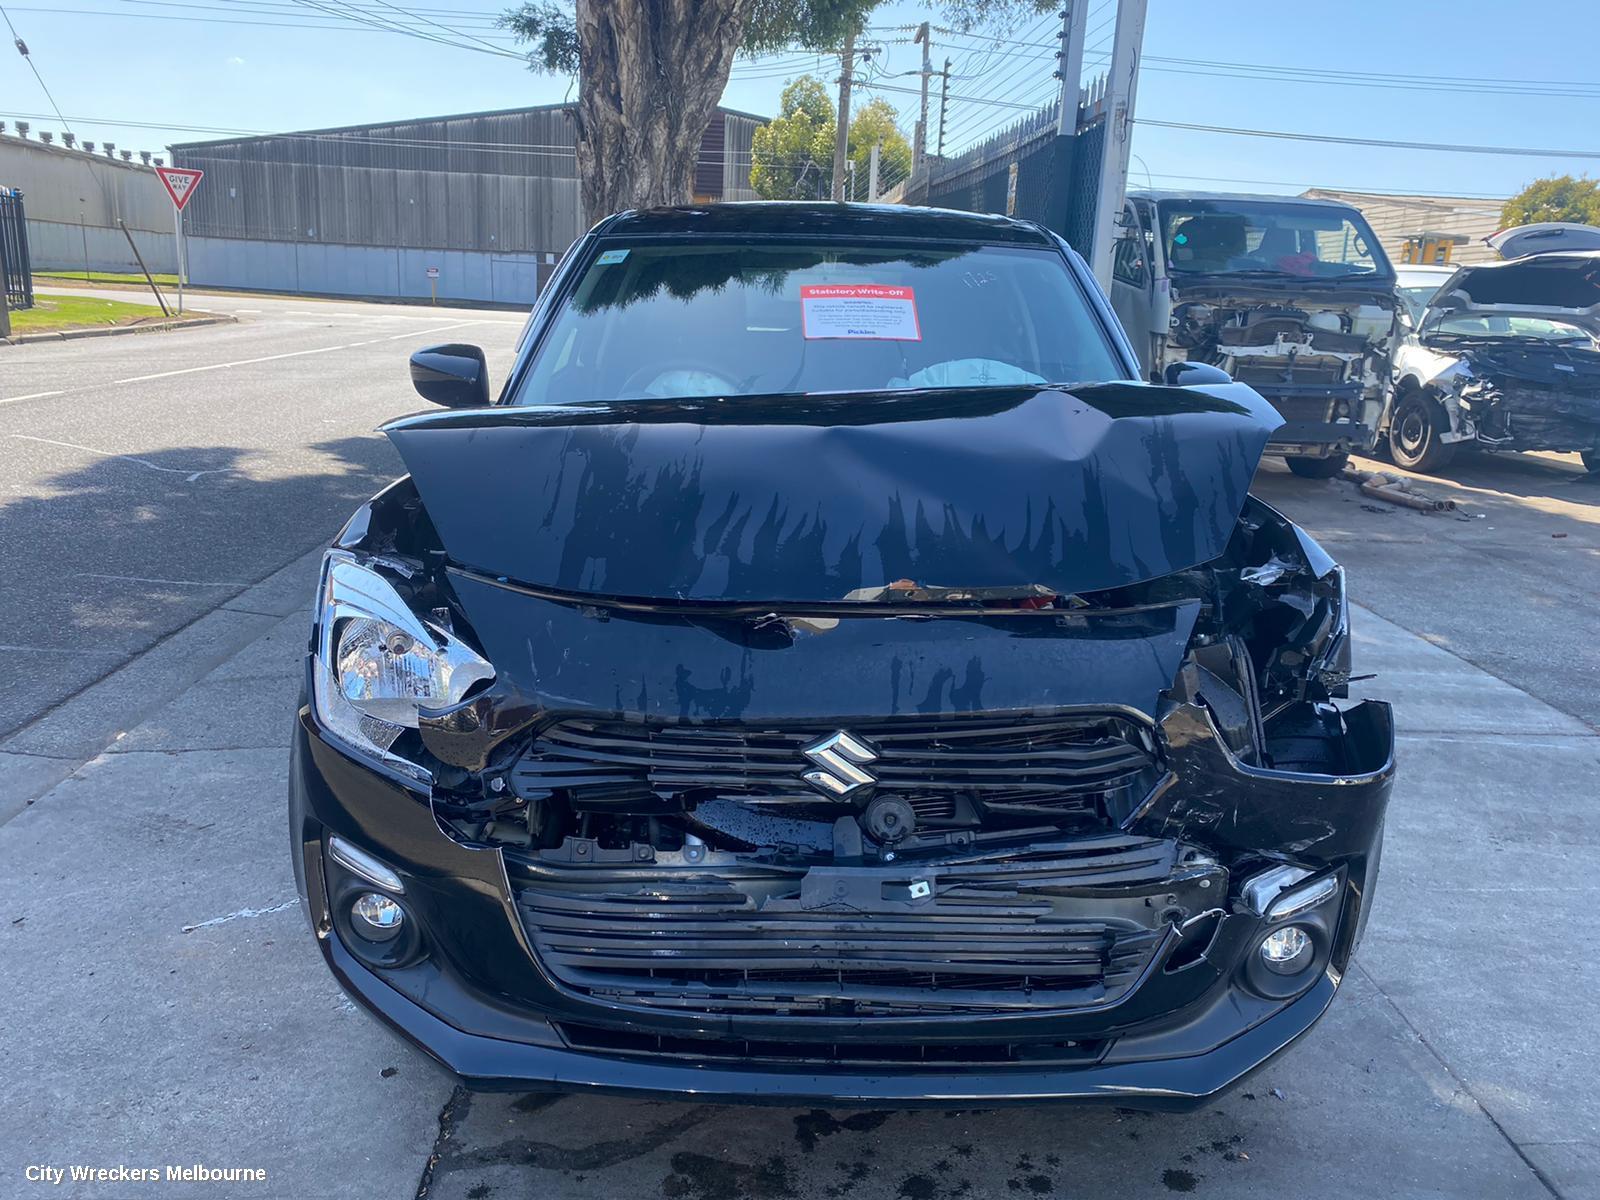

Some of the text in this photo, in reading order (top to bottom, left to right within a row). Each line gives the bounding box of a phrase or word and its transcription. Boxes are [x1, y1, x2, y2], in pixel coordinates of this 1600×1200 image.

[169, 175, 189, 184] GIVE
[809, 288, 905, 296] Statutory Write-Off
